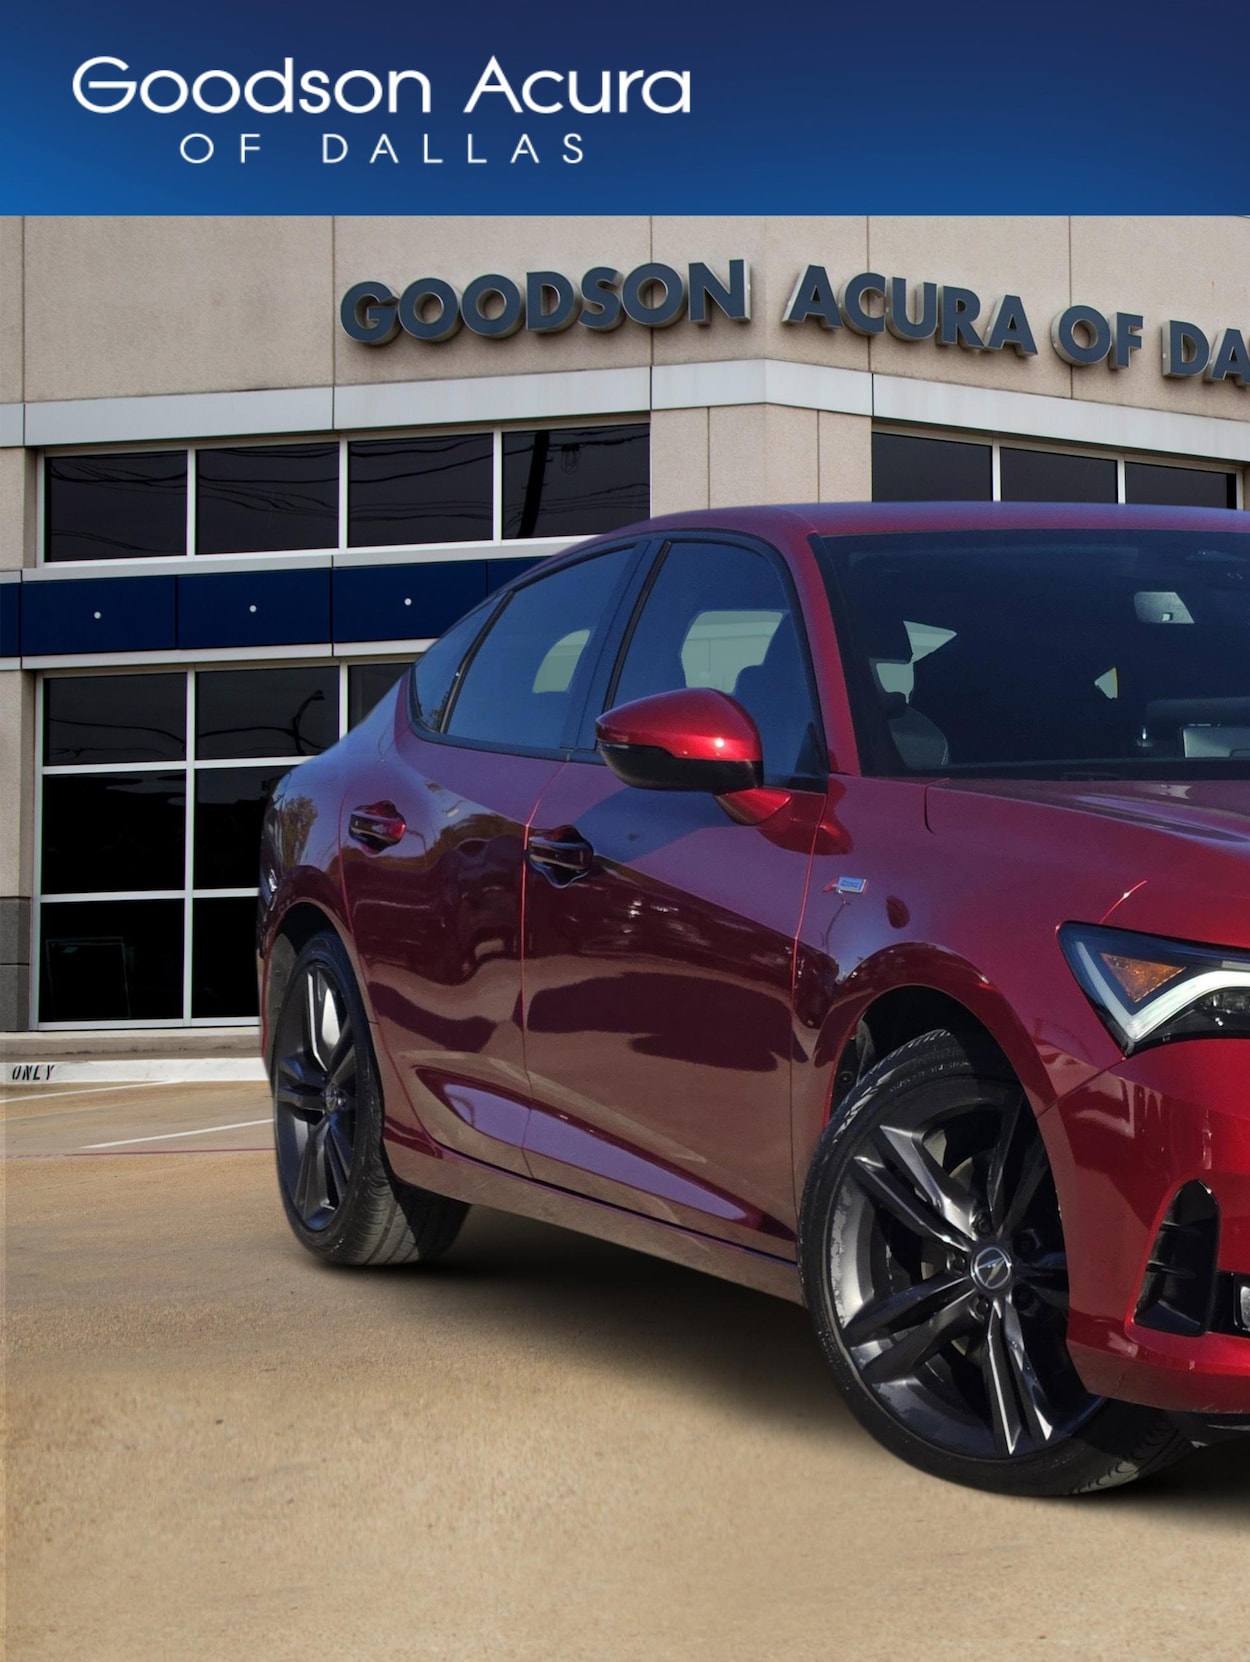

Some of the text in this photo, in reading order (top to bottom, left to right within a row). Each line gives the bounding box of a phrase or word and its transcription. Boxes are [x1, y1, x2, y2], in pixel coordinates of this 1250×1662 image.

[340, 259, 751, 346] GOODSON
[782, 264, 1037, 358] ACURA
[1051, 304, 1144, 370] OF
[12, 1064, 55, 1081] ONLY
